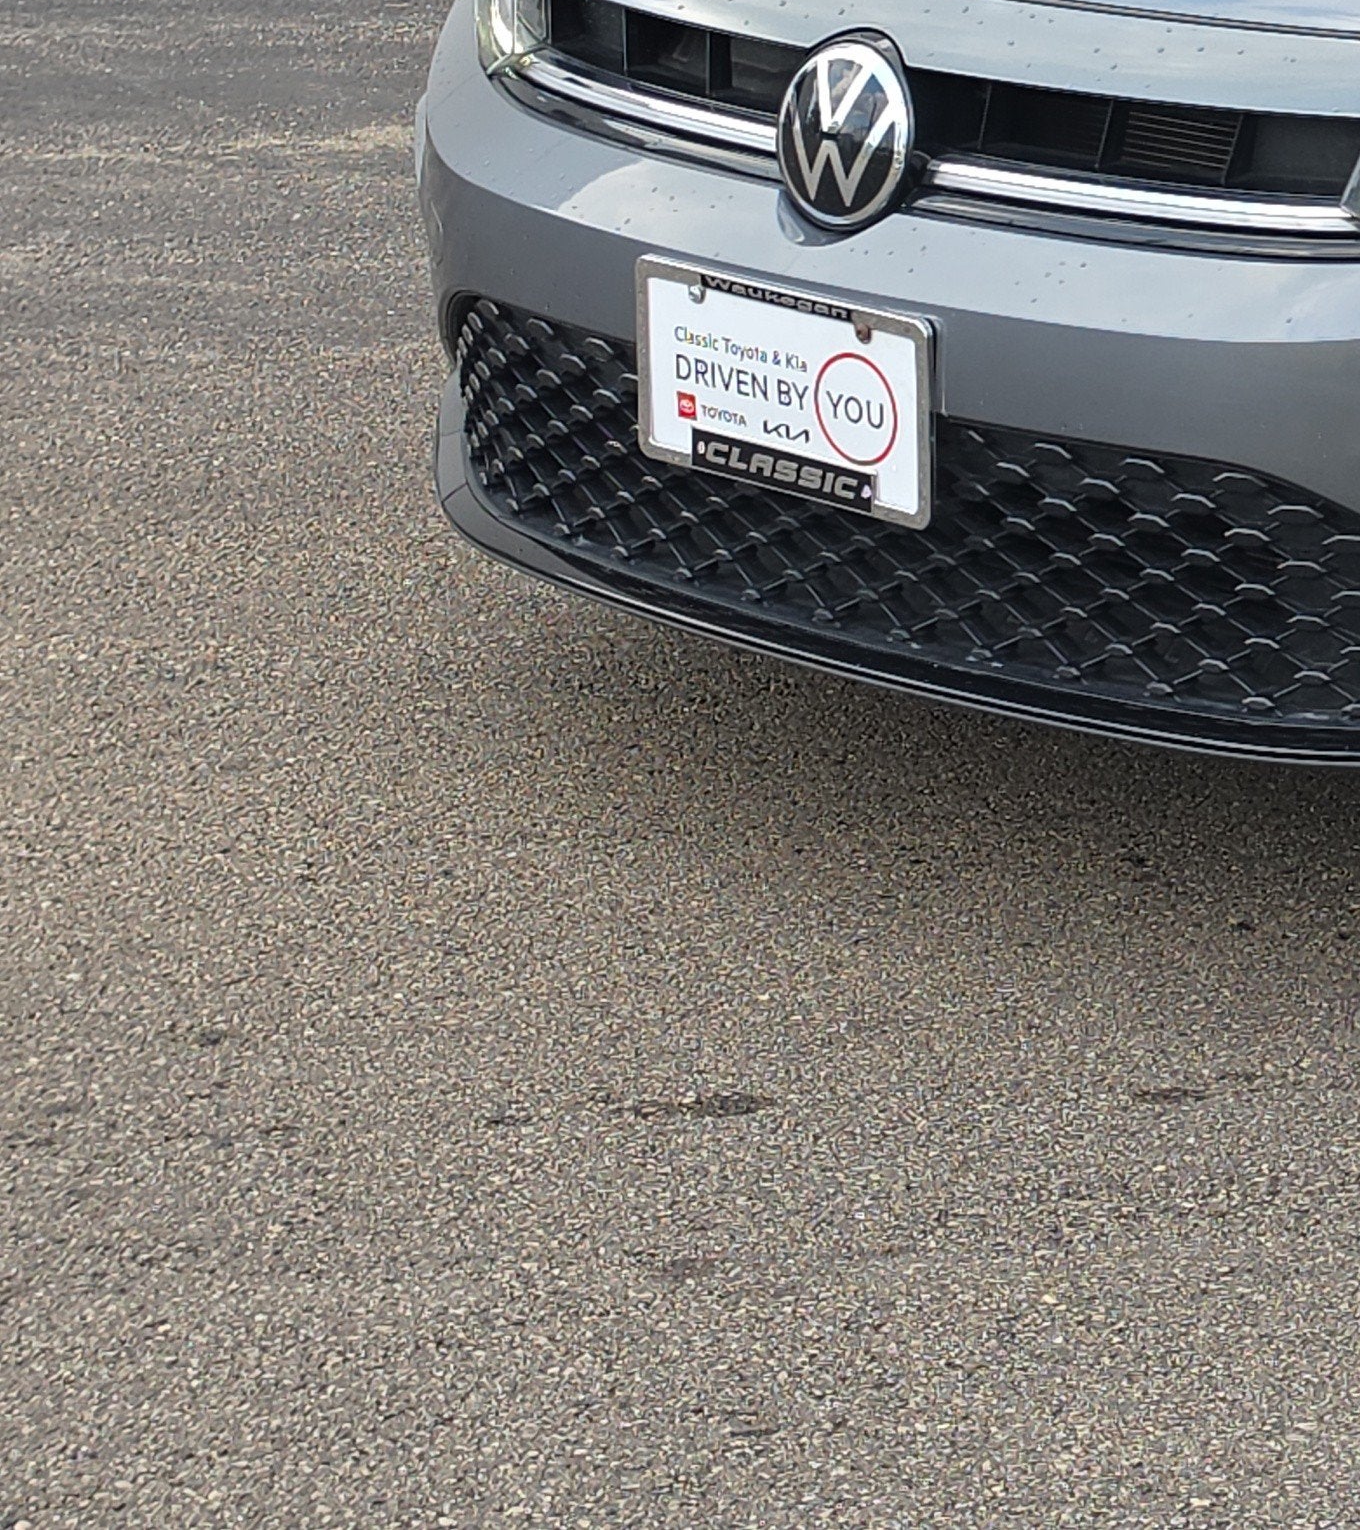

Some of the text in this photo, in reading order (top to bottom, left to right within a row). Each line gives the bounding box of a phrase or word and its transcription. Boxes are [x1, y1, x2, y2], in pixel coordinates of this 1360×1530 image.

[704, 274, 849, 320] Waukegan
[674, 325, 808, 373] Classic Toyota & Kia
[675, 353, 885, 430] DRIVEN BY YOU
[701, 404, 748, 428] TOYOTA
[705, 441, 858, 500] CLASSIC
